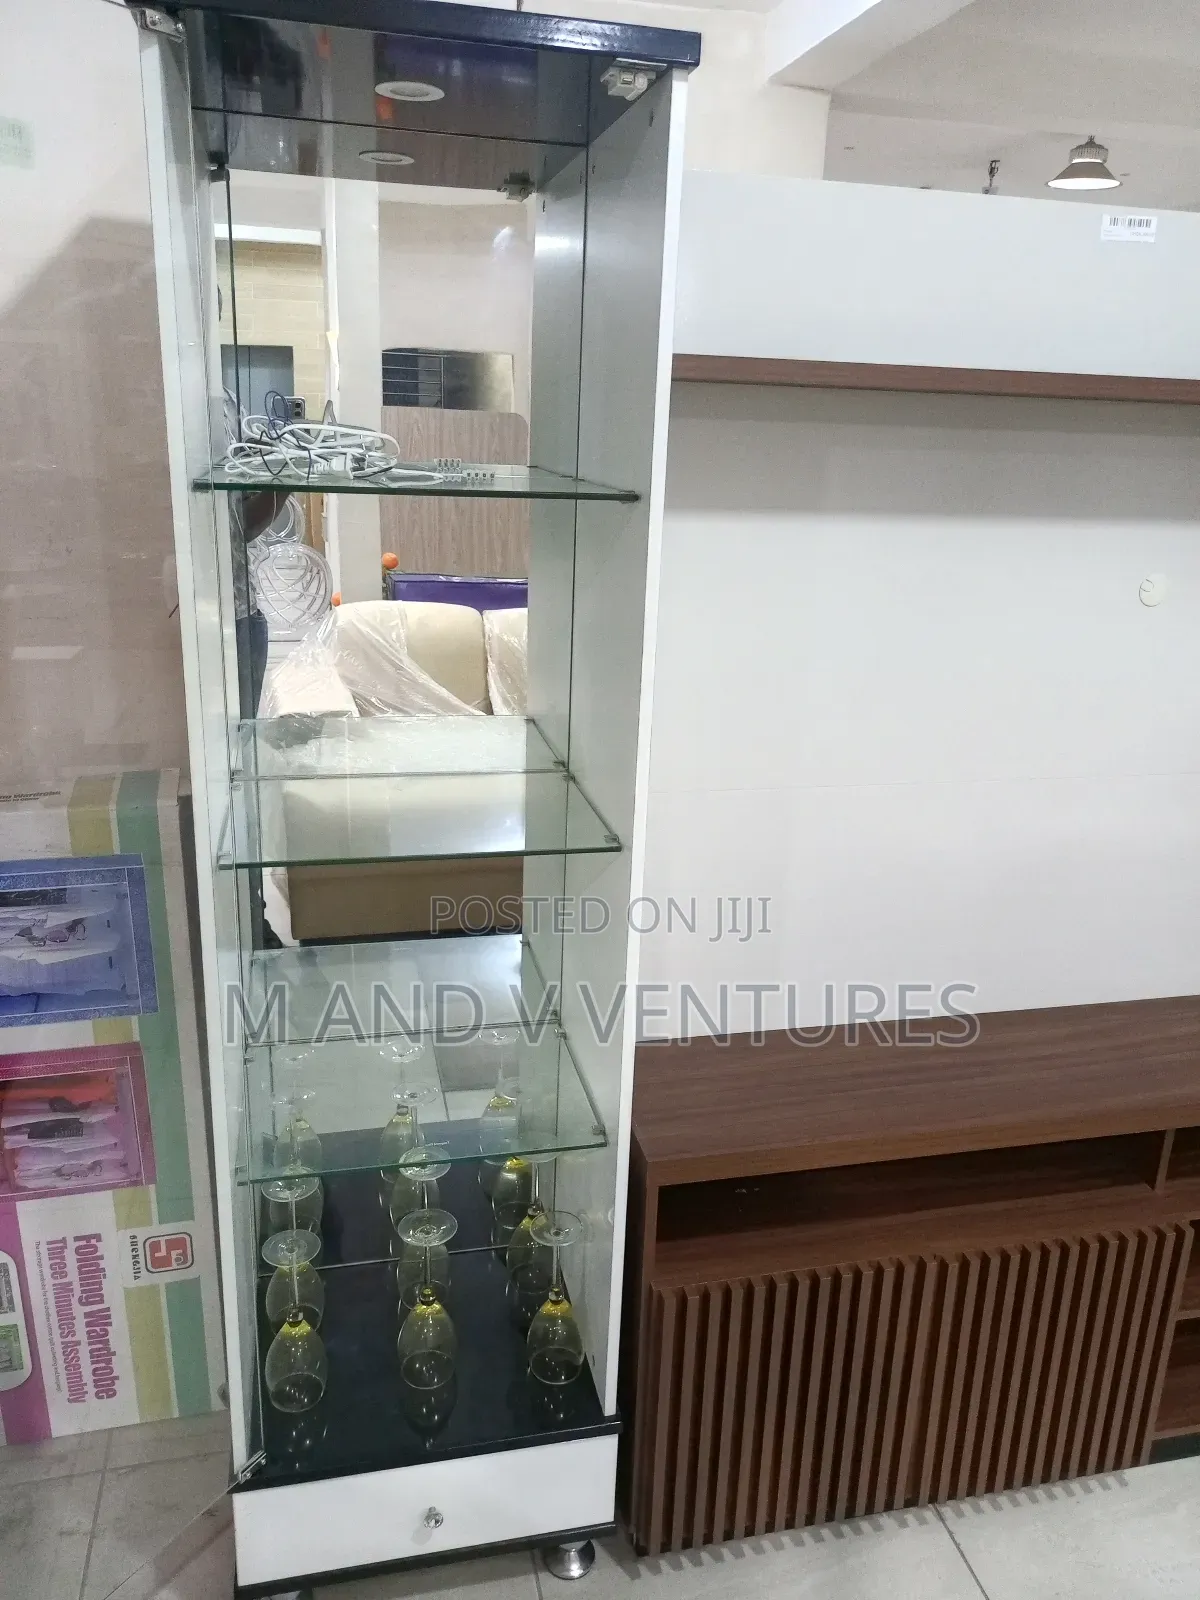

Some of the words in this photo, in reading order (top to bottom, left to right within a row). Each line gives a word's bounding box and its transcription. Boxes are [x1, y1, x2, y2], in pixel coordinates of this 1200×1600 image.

[46, 1236, 68, 1280] Three
[73, 1233, 107, 1306] Folding
[52, 1281, 77, 1339] Minutes
[60, 1339, 88, 1404] Assembly
[83, 1306, 120, 1400] Wardrobe
